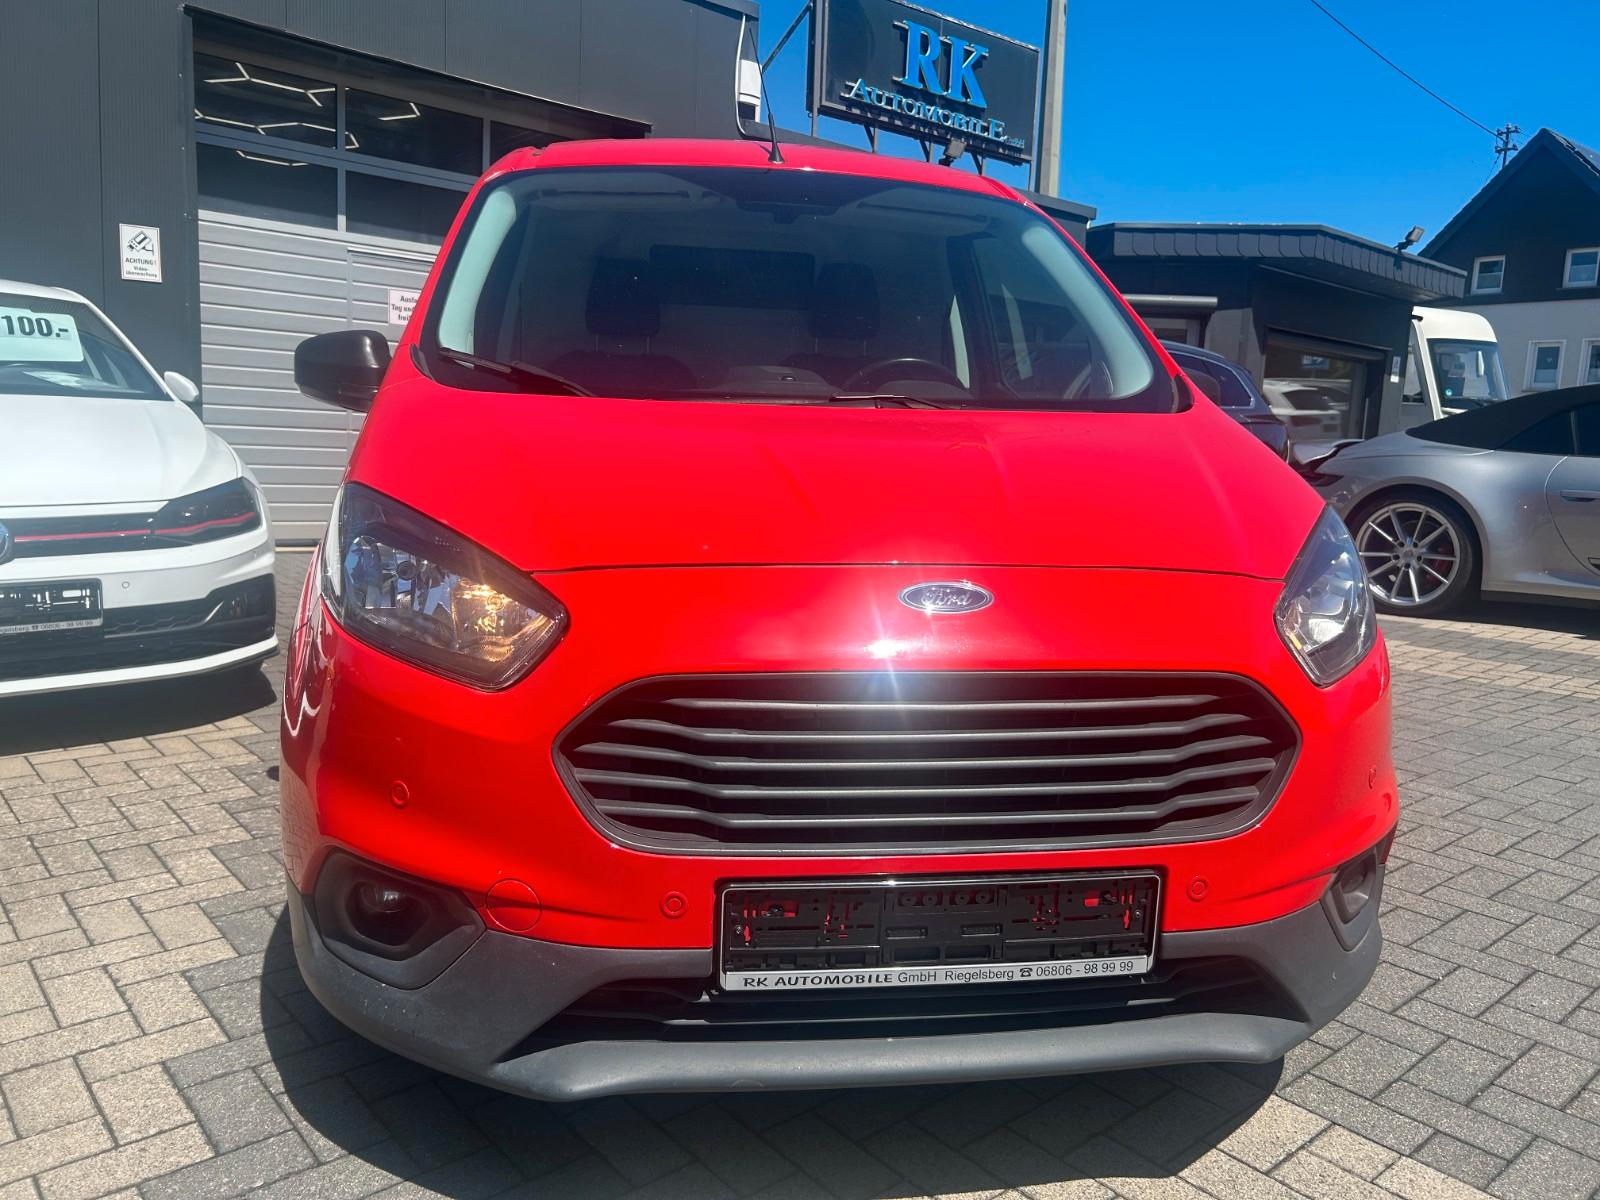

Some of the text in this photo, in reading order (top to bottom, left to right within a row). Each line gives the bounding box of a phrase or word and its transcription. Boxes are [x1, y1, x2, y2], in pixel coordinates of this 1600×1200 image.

[893, 20, 989, 109] RK
[840, 78, 1007, 141] AUTOMOBILE
[921, 586, 972, 606] Ford
[743, 977, 768, 987] RK
[774, 974, 893, 987] AUTOMOBILE
[897, 971, 937, 983] GmbH
[944, 968, 1014, 982] Riegelsberg
[1036, 965, 1073, 976] 06806
[1083, 963, 1098, 974] 98
[1101, 962, 1116, 973] 99
[1119, 961, 1134, 972] 99
